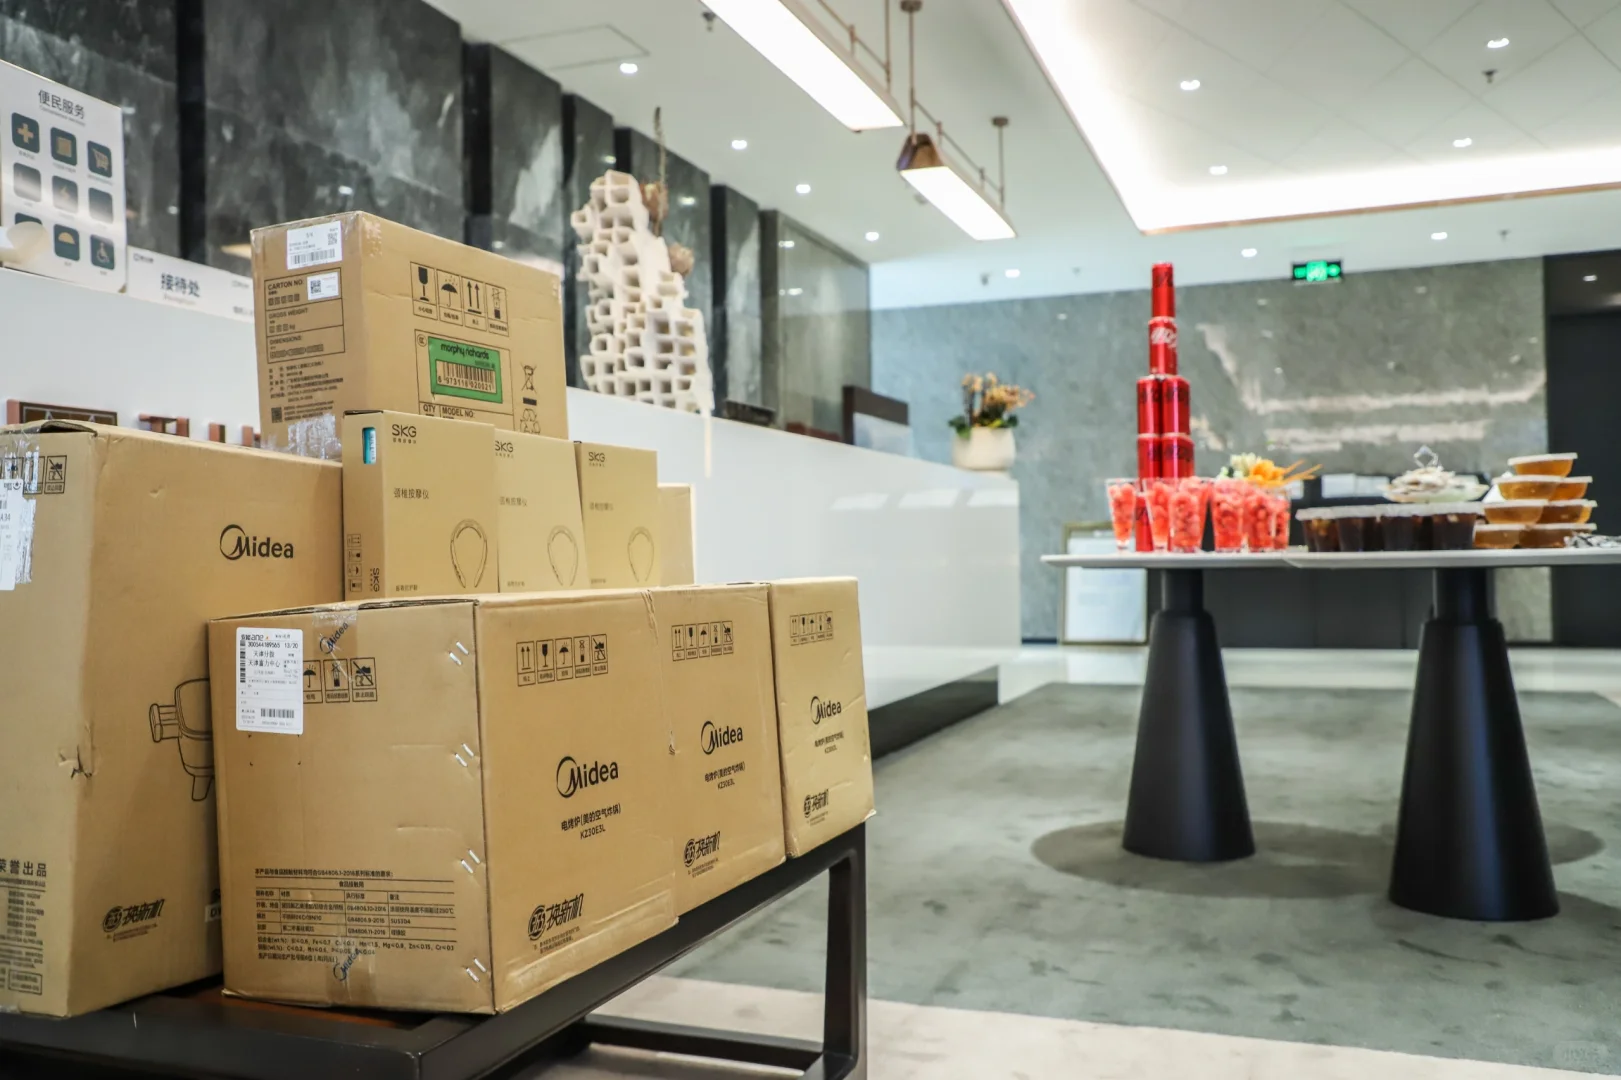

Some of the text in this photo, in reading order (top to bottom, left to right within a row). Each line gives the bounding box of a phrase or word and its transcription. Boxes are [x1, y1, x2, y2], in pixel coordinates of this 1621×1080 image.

[38, 89, 84, 119] 便民服务
[161, 273, 200, 298] 接待处
[268, 280, 293, 291] CARTON
[440, 343, 490, 360] morphy richards
[423, 404, 436, 413] QTY
[442, 406, 464, 417] MODEL
[392, 424, 417, 438] SKG
[495, 441, 514, 453] SKG
[588, 451, 606, 463] SKG
[394, 488, 430, 499] 颈椎按摩仪
[220, 524, 294, 561] Midea
[372, 567, 380, 592] SKG
[320, 621, 349, 655] Midea
[810, 696, 842, 725] Midea
[701, 720, 744, 756] Midea
[556, 755, 619, 799] Midea
